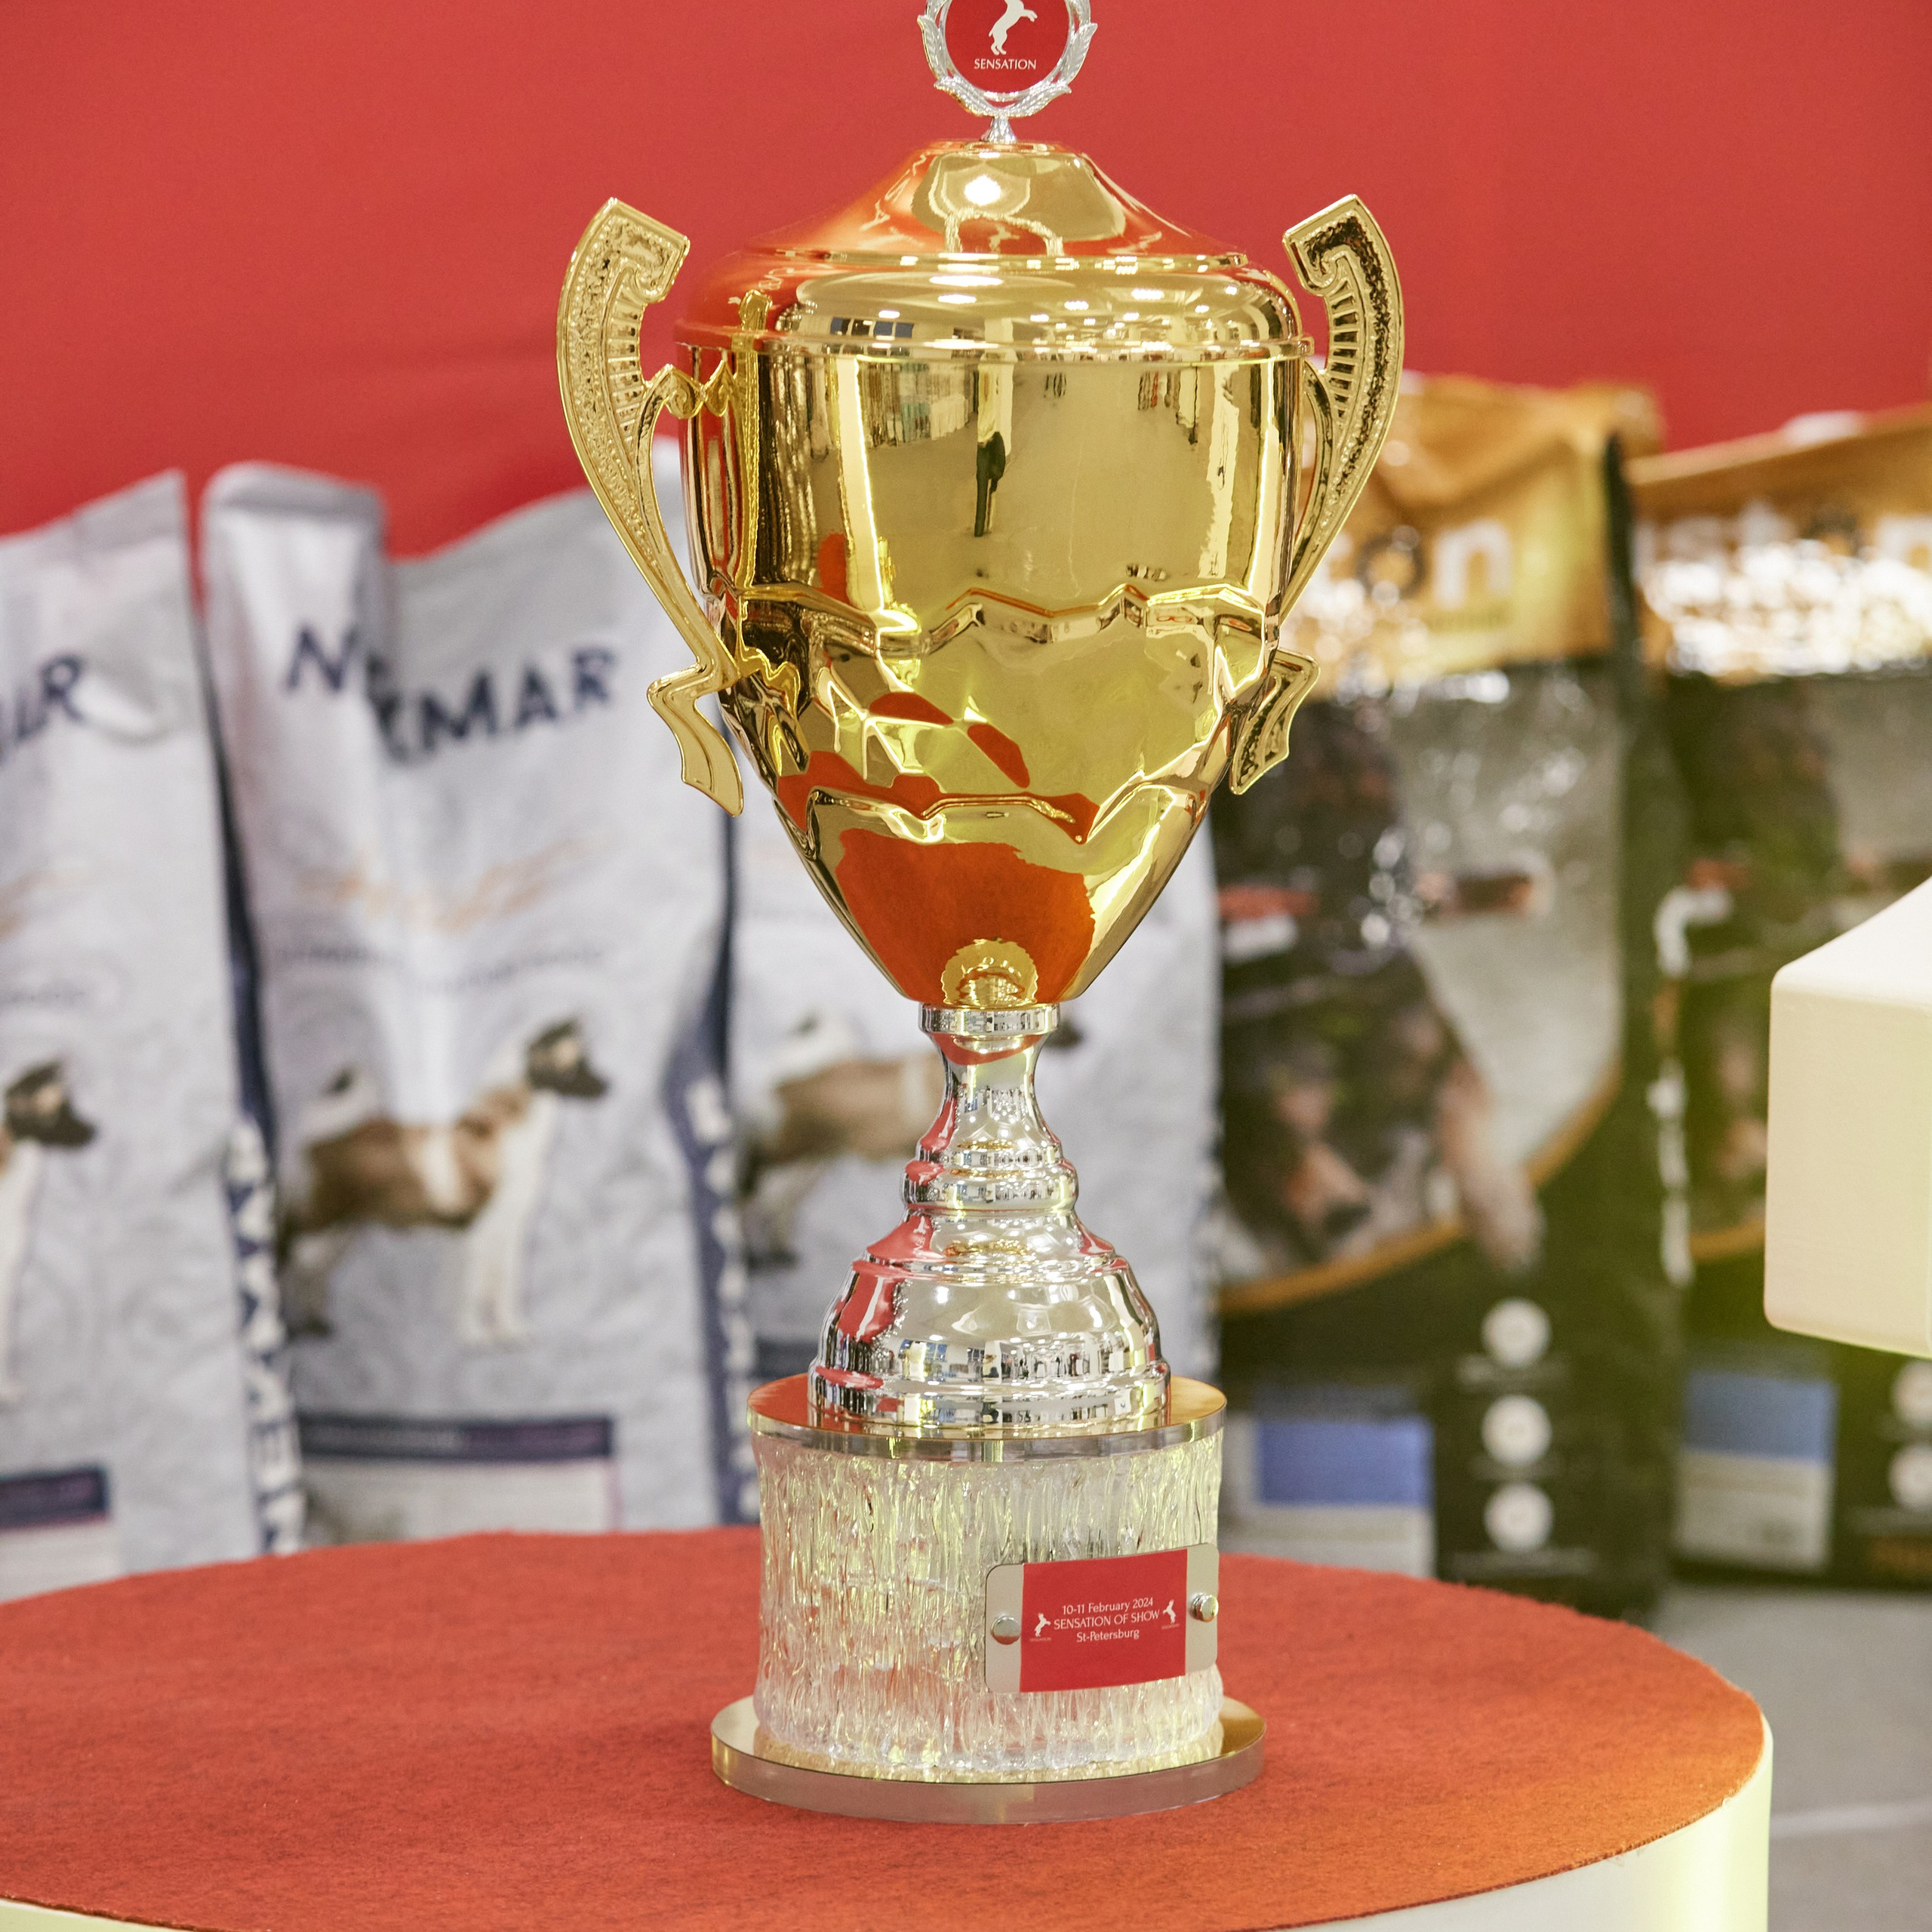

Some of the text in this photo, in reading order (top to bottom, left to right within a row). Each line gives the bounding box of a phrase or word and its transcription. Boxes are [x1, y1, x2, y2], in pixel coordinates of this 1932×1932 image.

[974, 58, 1037, 70] SENSATION
[1063, 1597, 1154, 1615] 10-11 February 2024
[1054, 1609, 1160, 1630] SENSATION OF SHOW
[1076, 1629, 1140, 1643] St-Petersburg
